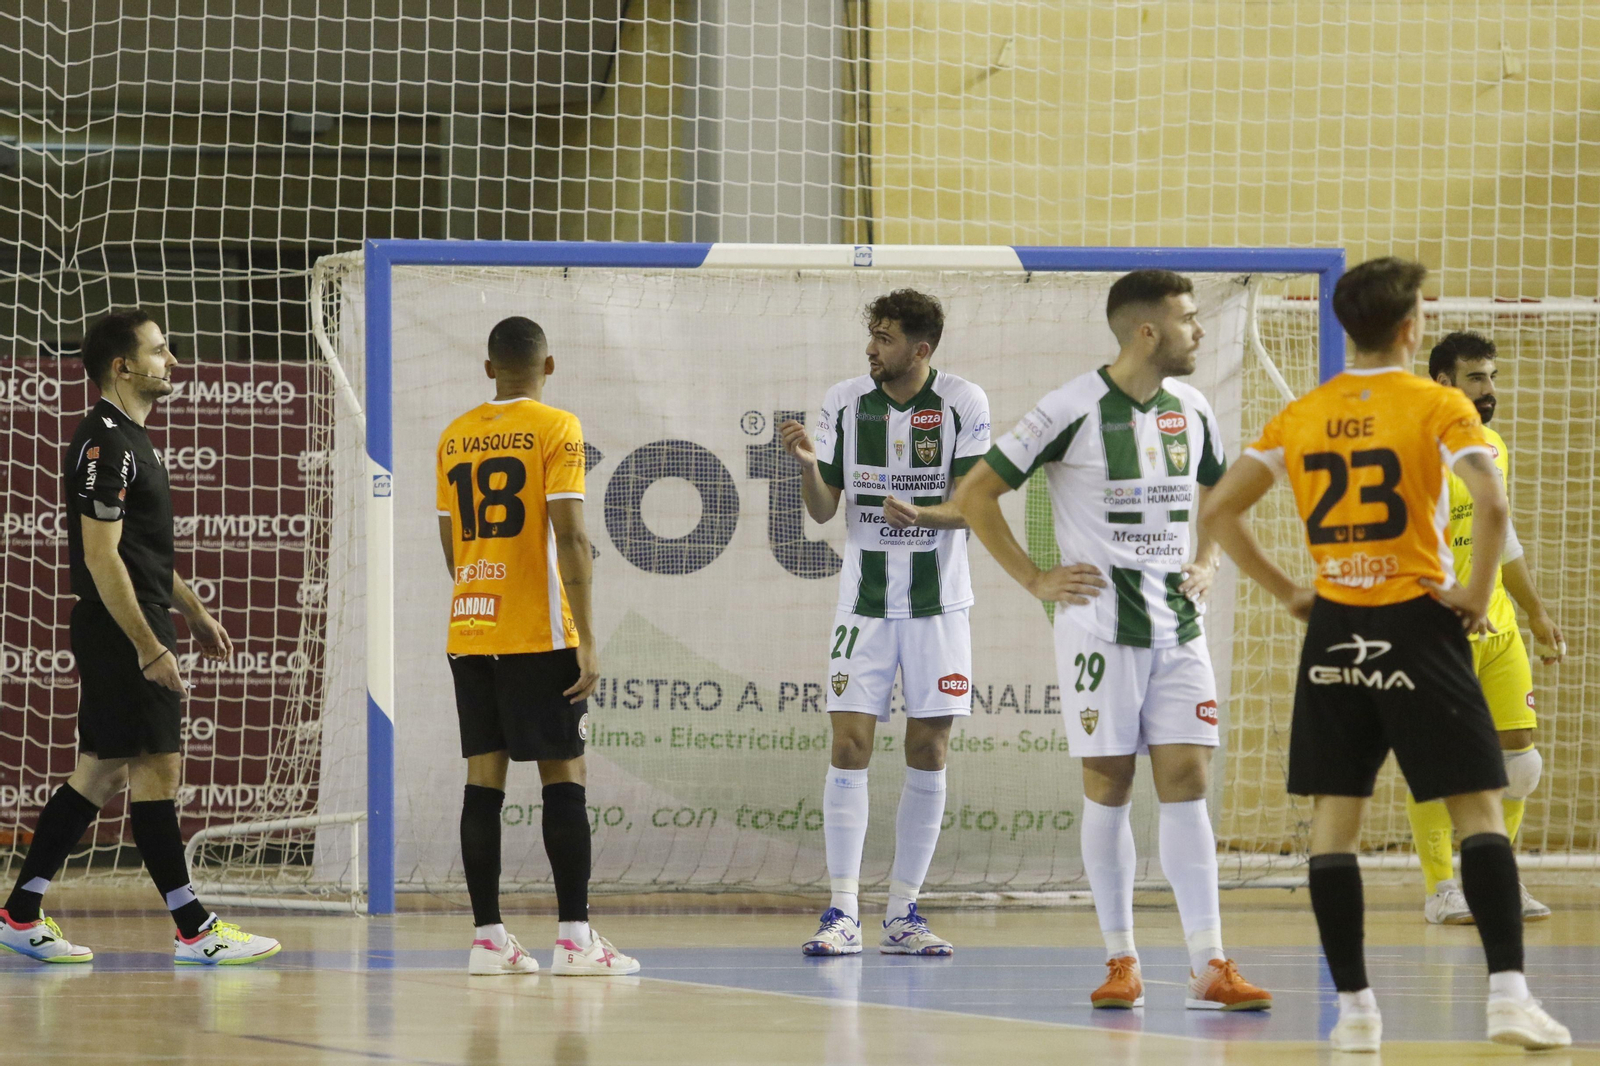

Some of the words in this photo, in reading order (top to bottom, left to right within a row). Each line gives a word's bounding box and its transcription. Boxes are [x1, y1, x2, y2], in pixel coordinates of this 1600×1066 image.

[188, 380, 296, 404] IMDECO
[1326, 416, 1375, 439] UGE
[446, 439, 457, 455] G.
[462, 432, 535, 453] VASQUES
[853, 480, 886, 490] CÓRDOBA
[891, 481, 946, 491] HUMANIDAD
[892, 474, 940, 483] PATRIMONIO
[447, 456, 527, 542] 18
[1302, 446, 1409, 546] 23
[204, 514, 310, 537] IMDECO
[453, 597, 495, 617] SANDUA
[830, 624, 860, 660] 21
[1074, 651, 1106, 693] 29
[1308, 665, 1416, 690] GIMA
[736, 681, 763, 712] A
[585, 723, 646, 748] lima
[670, 726, 828, 751] Electricidad
[651, 806, 718, 829] con
